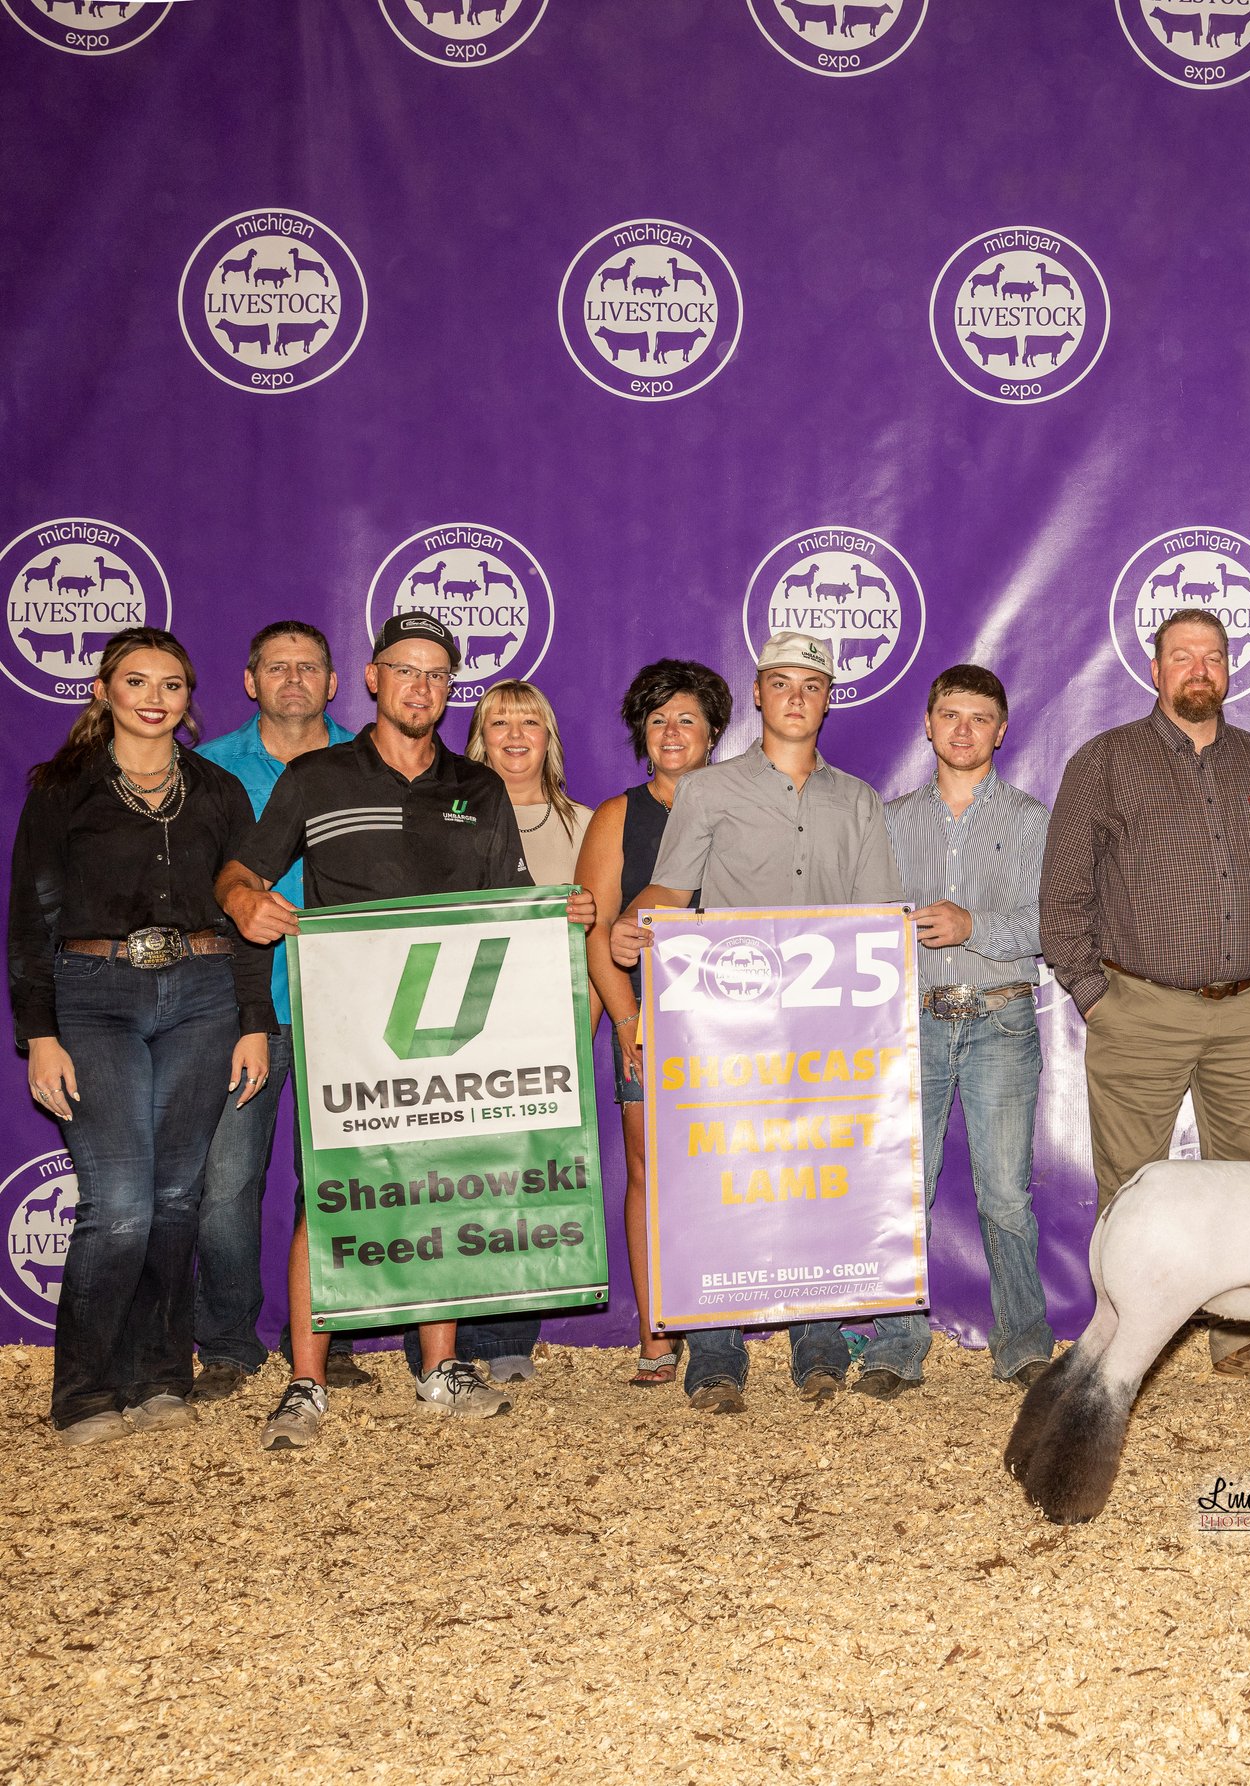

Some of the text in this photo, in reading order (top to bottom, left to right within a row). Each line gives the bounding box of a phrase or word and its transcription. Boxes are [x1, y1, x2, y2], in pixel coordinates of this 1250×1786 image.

[65, 30, 109, 49] expo
[445, 41, 487, 61] expo
[817, 52, 861, 71] expo
[1184, 63, 1226, 83] expo
[235, 214, 315, 240] michigan
[613, 225, 694, 249] michigan
[983, 231, 1061, 254] michigan
[206, 292, 338, 315] LIVESTOCK
[586, 301, 715, 324] LIVESTOCK
[957, 305, 1083, 328] LIVESTOCK
[251, 370, 294, 389] expo
[630, 378, 673, 397] expo
[1000, 382, 1042, 400] expo
[37, 523, 120, 547] michigan
[424, 528, 504, 552] michigan
[798, 534, 876, 556] michigan
[1163, 532, 1240, 554] michigan
[10, 601, 142, 623] LIVESTOCK
[771, 608, 898, 629] LIVESTOCK
[449, 685, 485, 701] xpo
[322, 1065, 572, 1114] UMBARGER
[342, 1102, 558, 1132] SHOW FEEDS EST. 1939
[688, 1113, 879, 1157] MARKET
[316, 1156, 587, 1214] Sharbowski
[721, 1165, 849, 1205] LAMB
[332, 1220, 584, 1269] Feed Sales
[702, 1262, 879, 1287] BELIEVE BUILD GROW
[698, 1294, 724, 1305] OUR
[774, 1288, 800, 1299] OUR
[800, 1281, 884, 1297] AGRICULTURE
